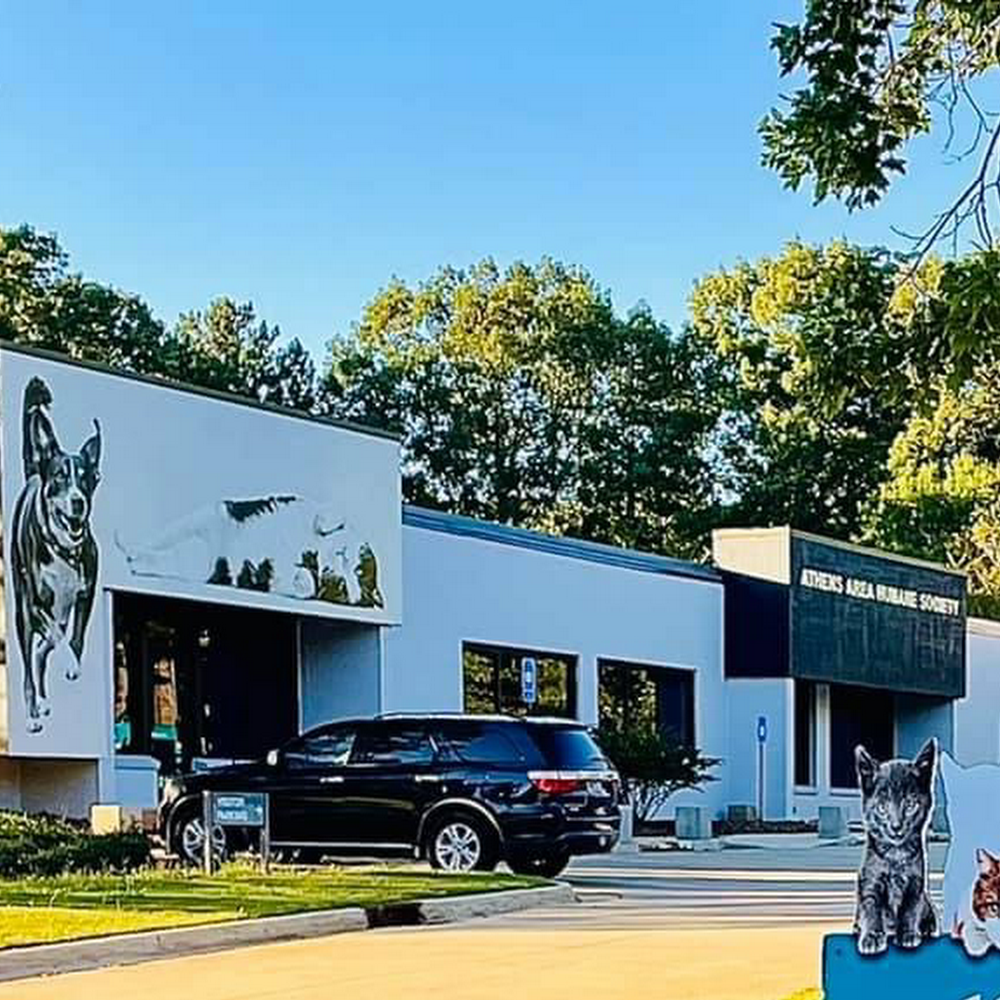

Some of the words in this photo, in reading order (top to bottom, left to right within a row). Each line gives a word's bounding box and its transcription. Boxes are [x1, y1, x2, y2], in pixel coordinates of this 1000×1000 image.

[801, 568, 844, 594] ATHENS
[846, 578, 875, 600] AREA
[876, 584, 918, 608] HUMANE
[919, 594, 960, 616] SOCIETY
